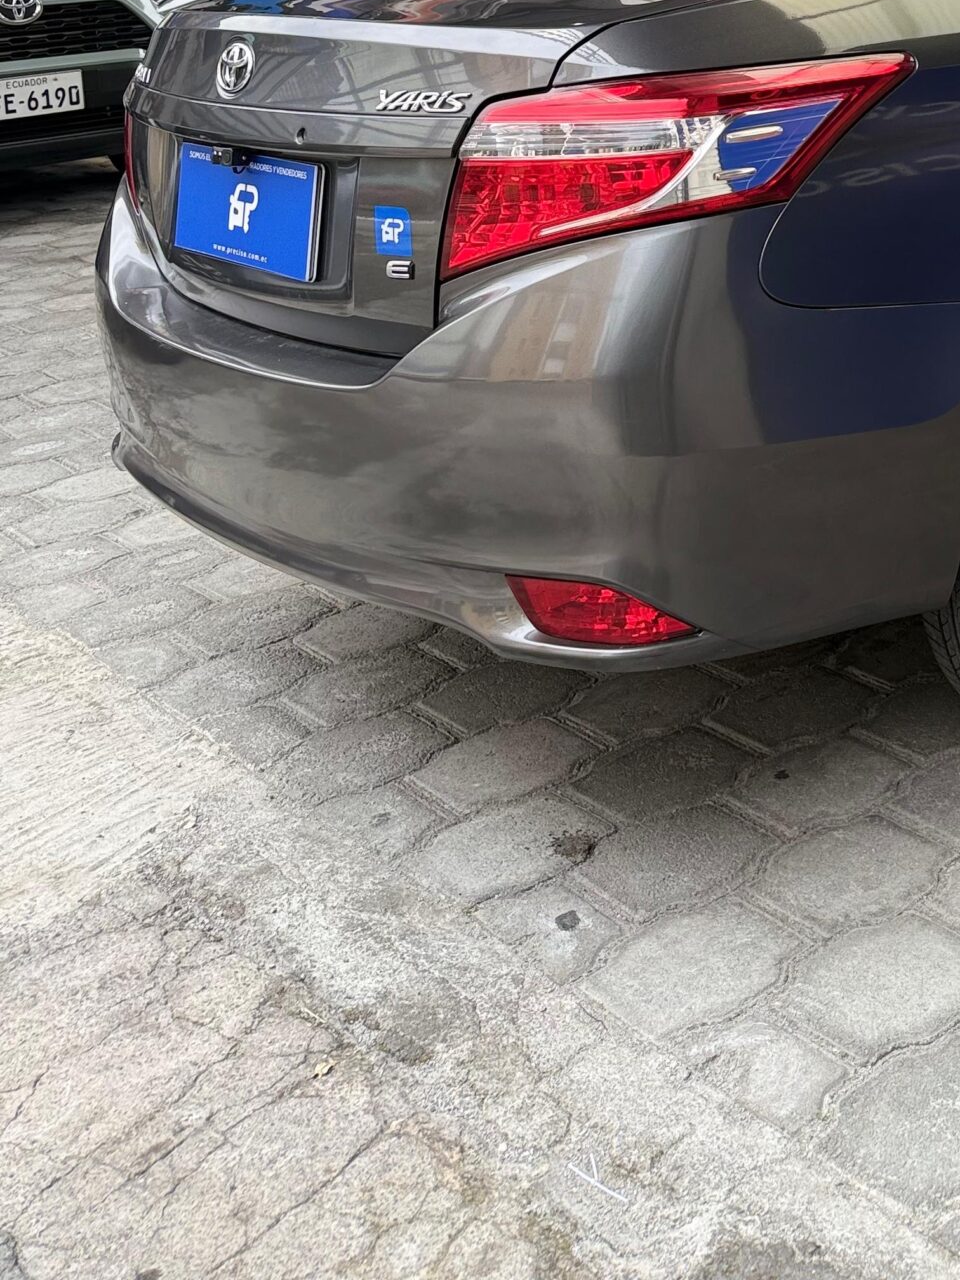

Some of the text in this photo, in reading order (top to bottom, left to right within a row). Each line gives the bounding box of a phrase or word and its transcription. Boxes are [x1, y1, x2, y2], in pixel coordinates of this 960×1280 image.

[5, 76, 48, 90] ECUADOR
[376, 89, 472, 112] YARIS
[386, 260, 414, 278] E
